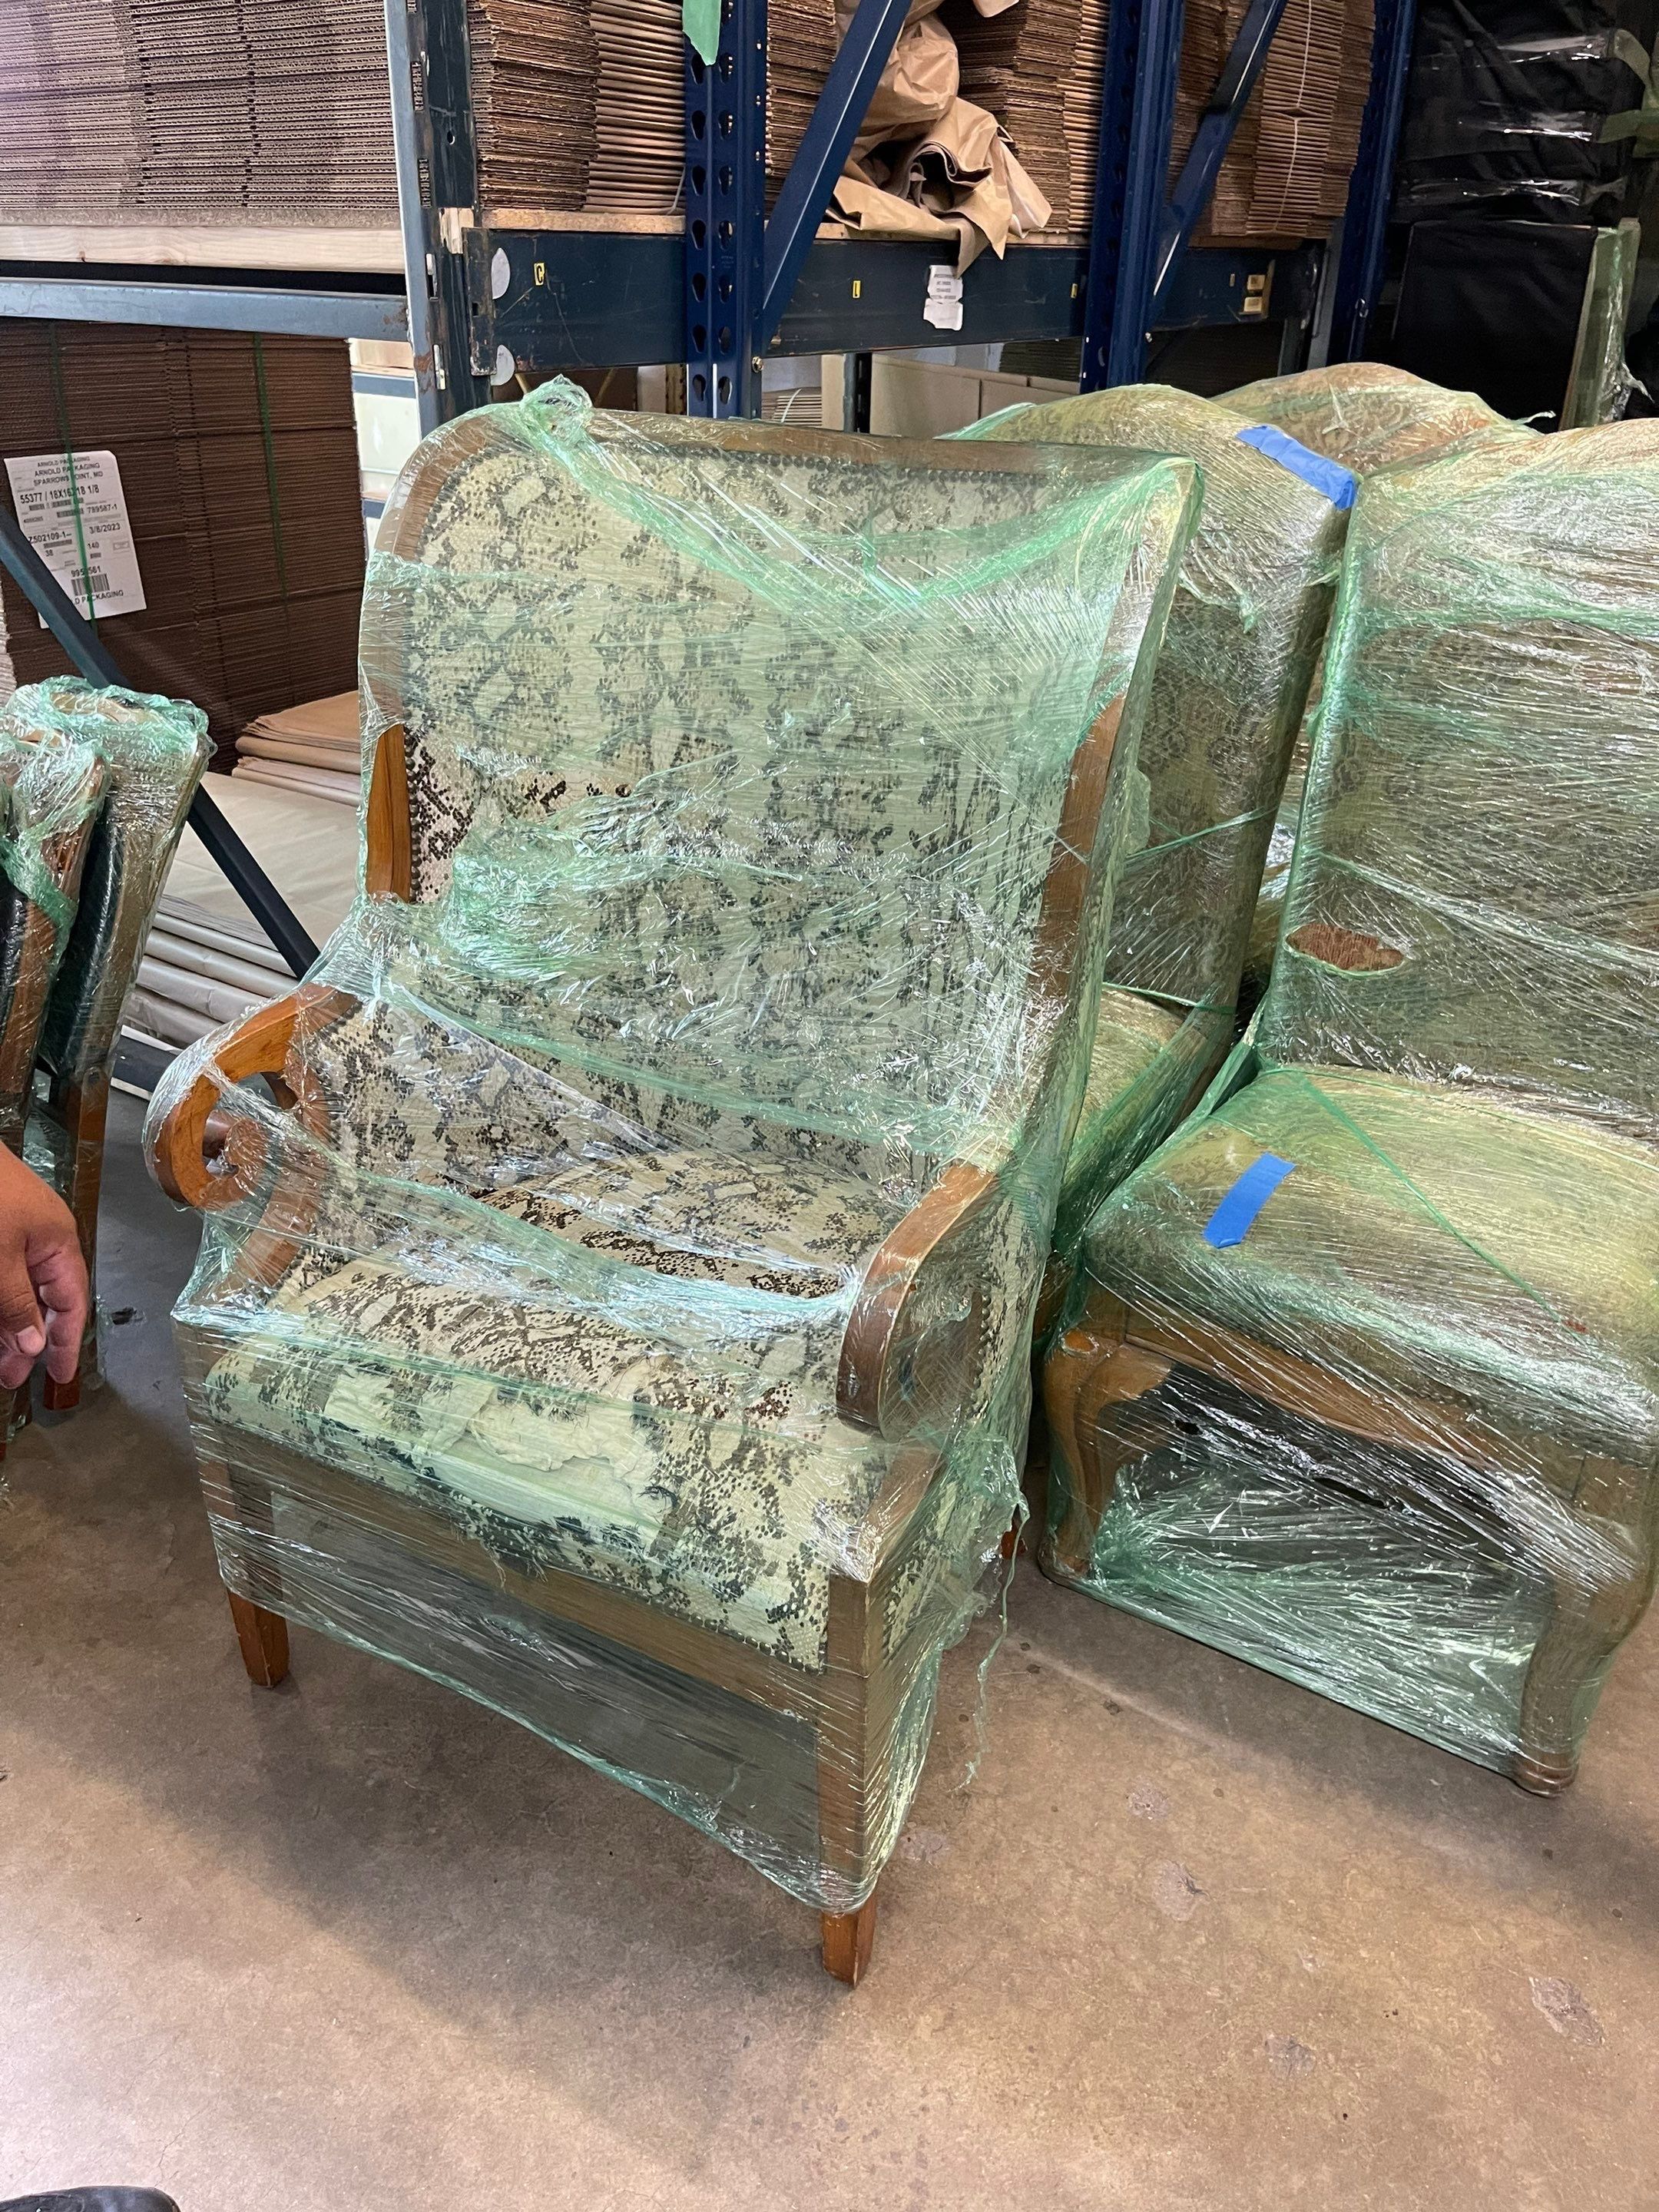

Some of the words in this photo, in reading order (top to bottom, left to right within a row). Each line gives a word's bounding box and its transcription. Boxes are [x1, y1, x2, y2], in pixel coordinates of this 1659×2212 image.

[60, 456, 91, 465] PAAGING
[35, 468, 61, 477] ARNOLD
[62, 462, 100, 474] PAKAGING
[33, 475, 69, 487] SPARROWS
[71, 471, 93, 482] OINT,
[20, 492, 42, 505] 55377
[88, 484, 100, 494] 1/8
